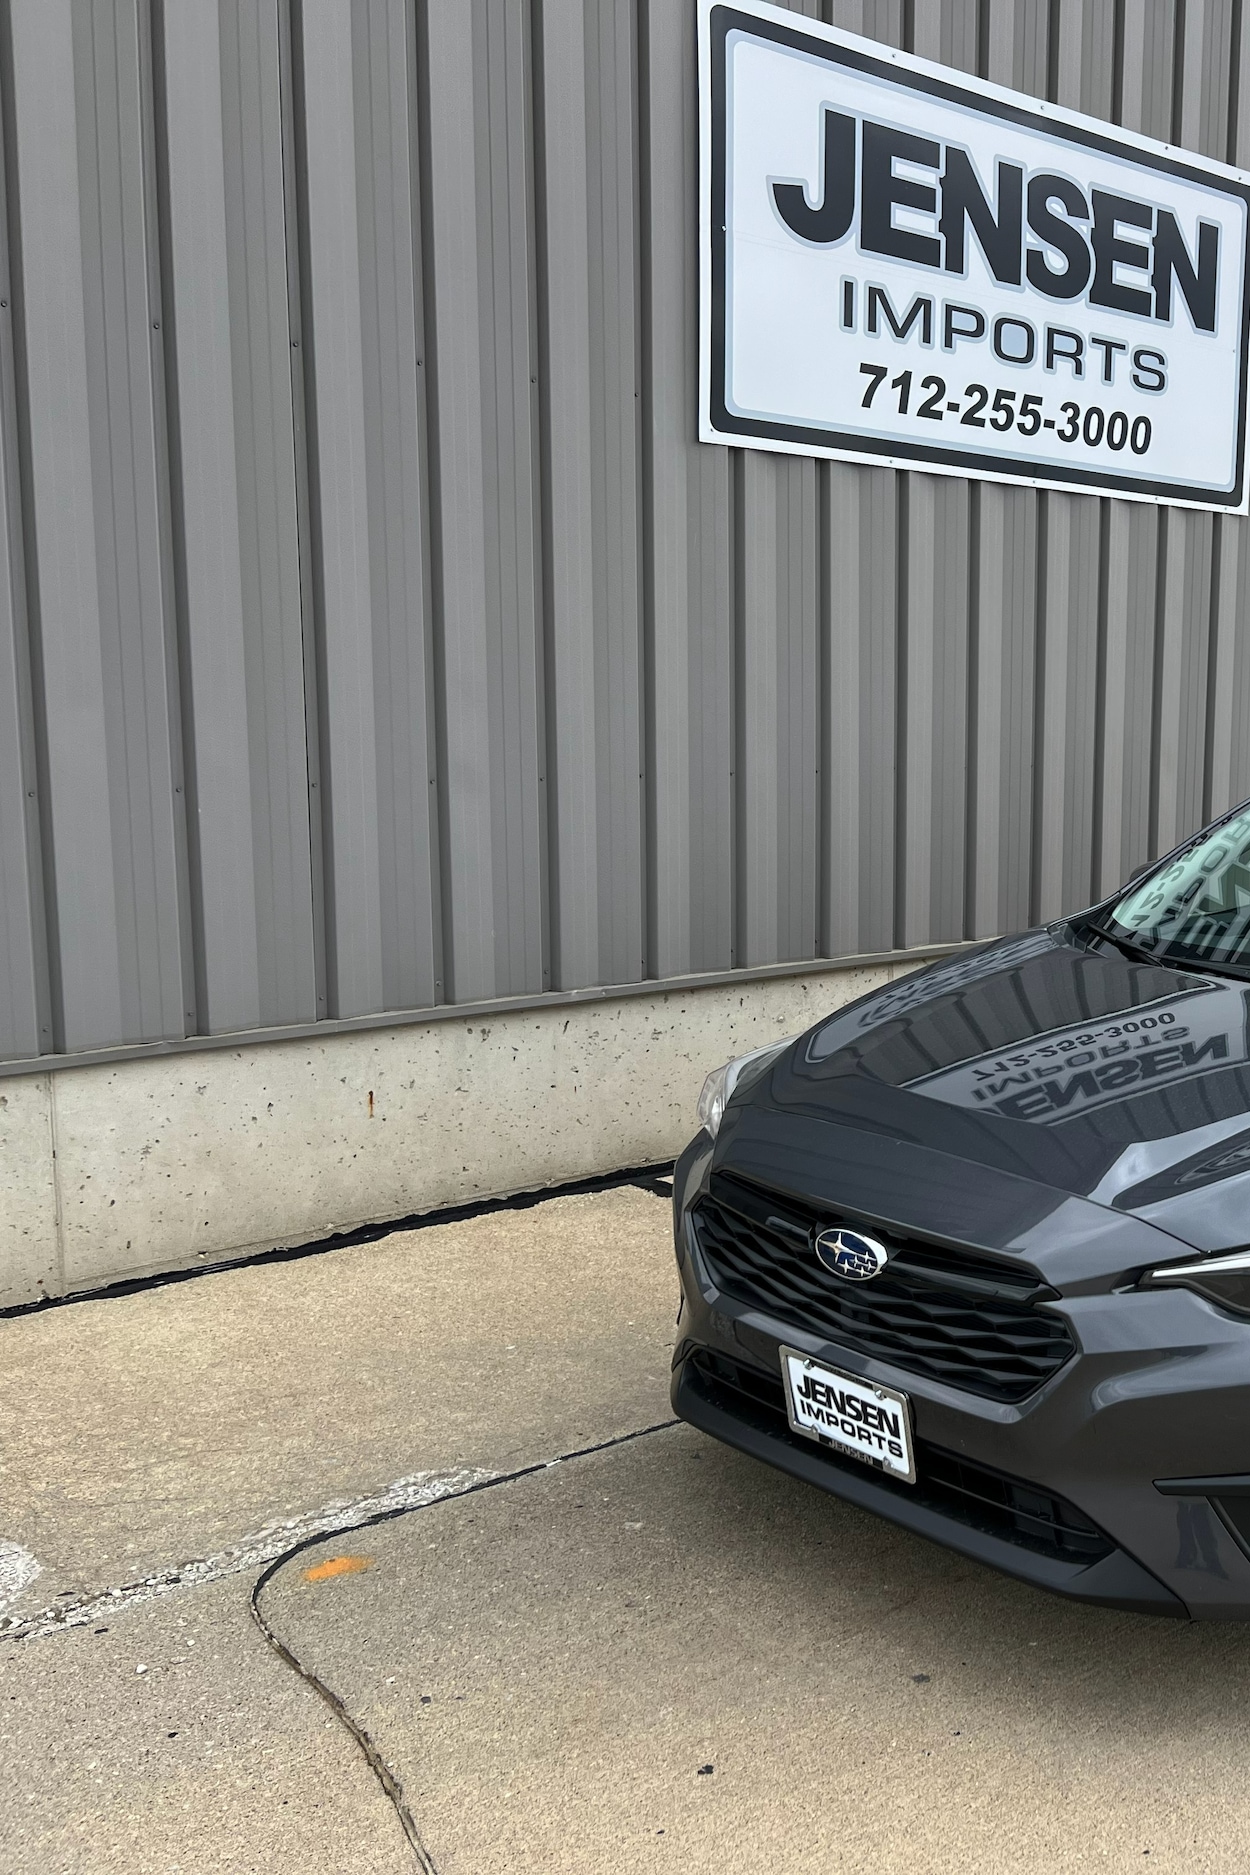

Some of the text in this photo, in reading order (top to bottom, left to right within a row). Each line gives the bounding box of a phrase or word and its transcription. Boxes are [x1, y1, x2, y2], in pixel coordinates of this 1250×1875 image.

[768, 103, 1220, 334] JENSEN
[841, 276, 1168, 394] IMPORTS
[858, 362, 1153, 455] 712-255-3000
[797, 1375, 900, 1439] JENSEN
[801, 1400, 903, 1458] IMPORTS
[829, 1440, 873, 1465] JENSEN
